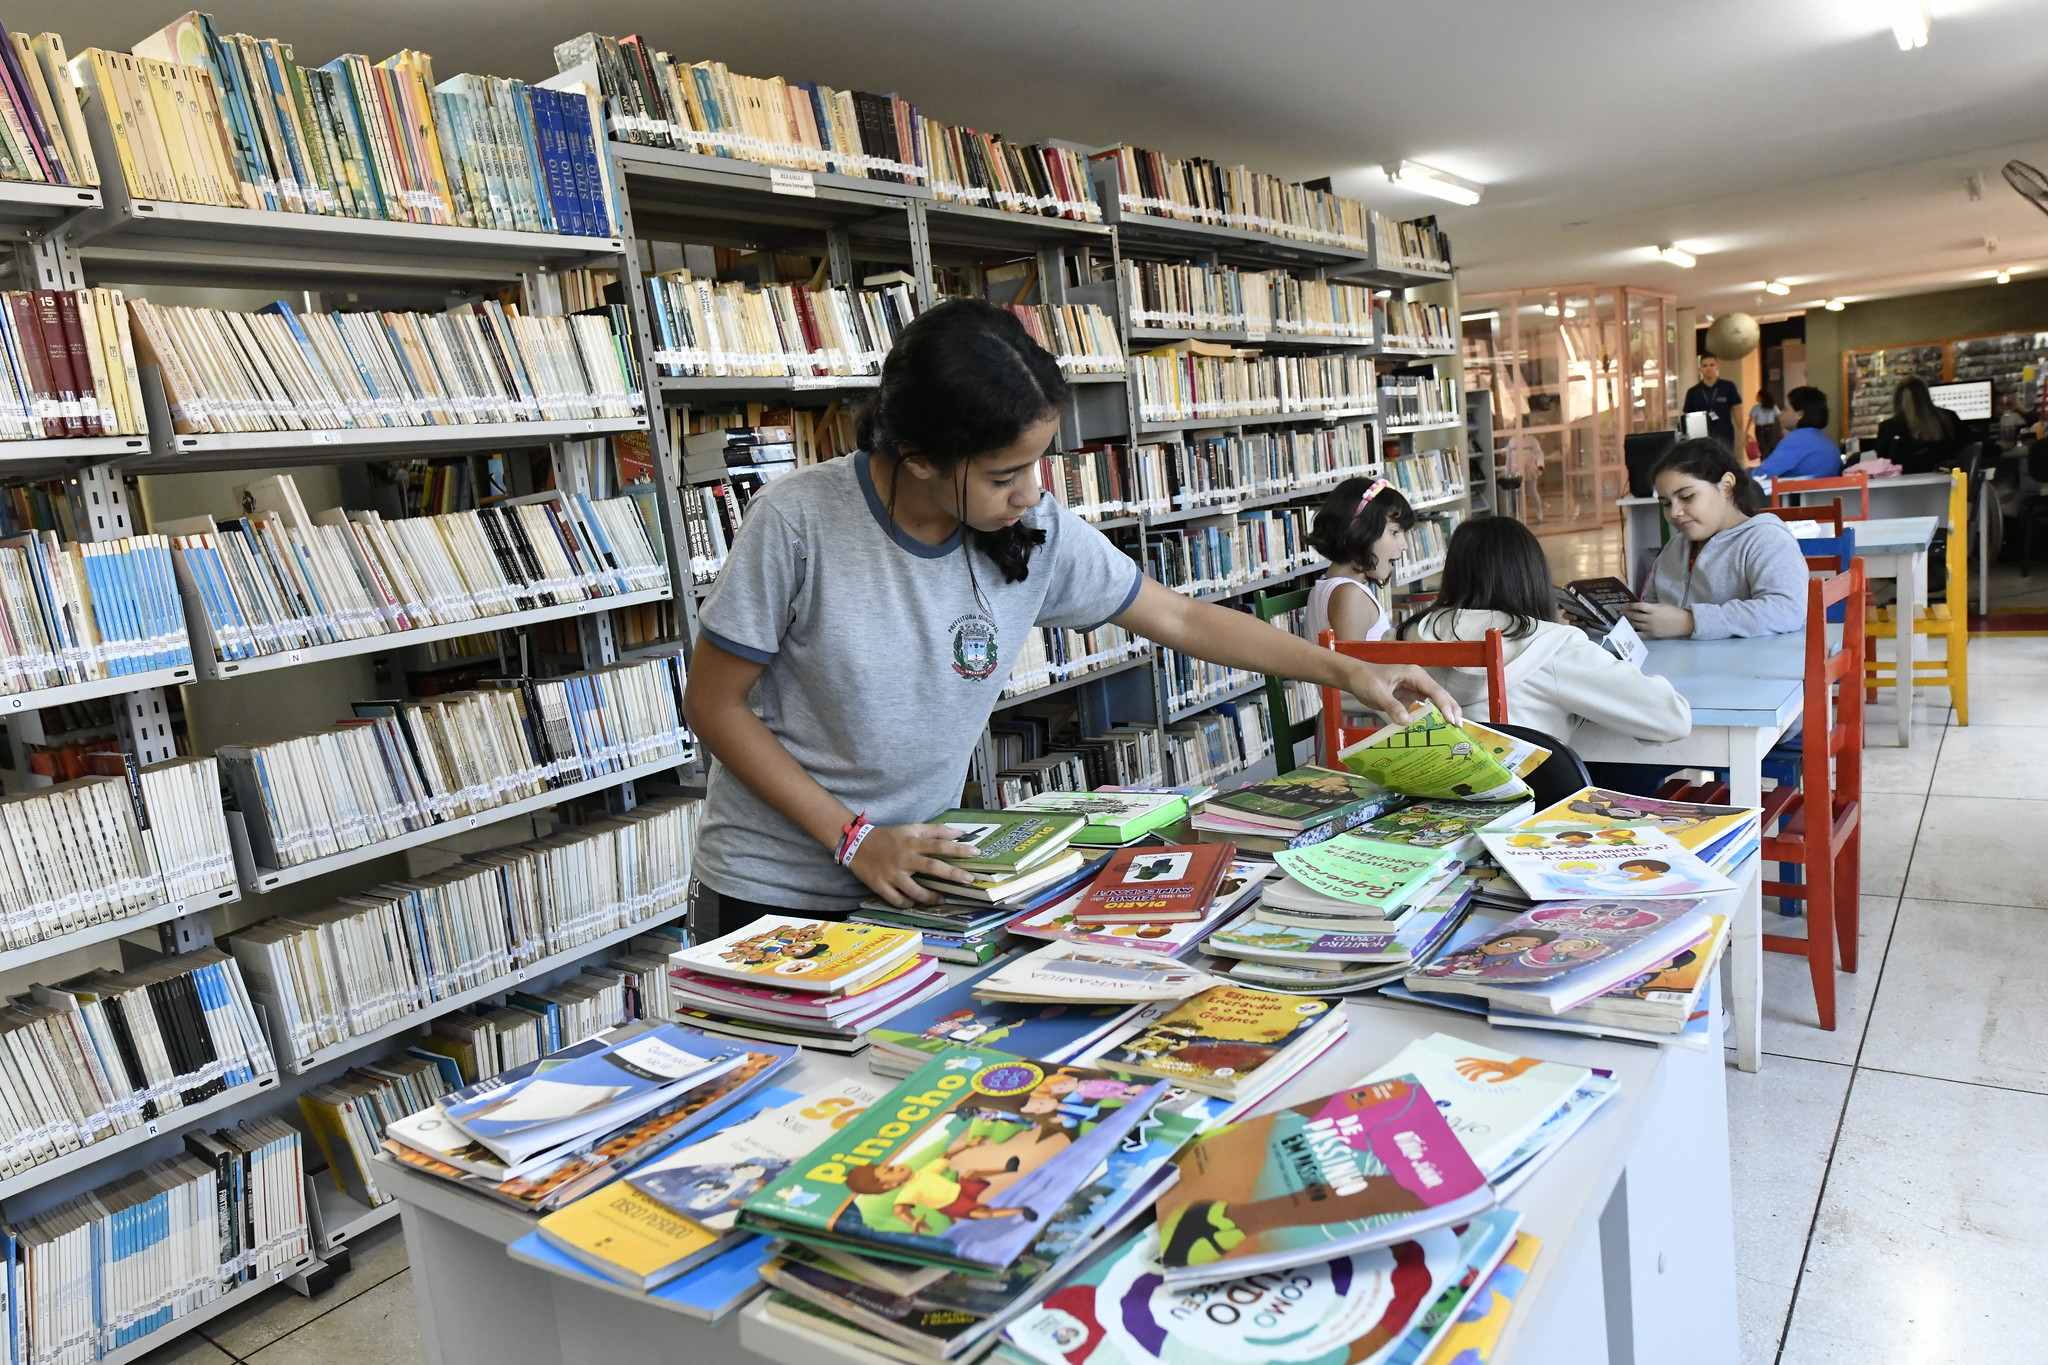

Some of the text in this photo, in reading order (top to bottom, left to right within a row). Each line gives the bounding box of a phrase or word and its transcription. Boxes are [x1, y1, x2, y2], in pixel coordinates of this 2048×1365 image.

[475, 122, 493, 177] MONTEIRO LOBATO
[485, 122, 501, 177] MONTEIRO LOBATO
[497, 124, 513, 179] MONTEIRO LOBATO
[505, 123, 520, 177] MONTEIRO LOBATO
[514, 126, 529, 179] MONTEIRO LOBATO
[39, 297, 55, 307] 15
[63, 298, 74, 306] 11
[948, 614, 1000, 634] PREFEITURA MUNICIPAL
[292, 654, 300, 662] N
[12, 699, 21, 708] O
[1013, 827, 1055, 852] DIÁRIO
[846, 851, 853, 861] DE
[1328, 844, 1429, 868] Descoladas
[1555, 852, 1648, 861] sexualidade
[1601, 844, 1670, 854] mentira?
[1324, 849, 1410, 874] Princesas
[1294, 855, 1395, 899] Paqueras
[1093, 887, 1194, 897] MINECRAFT
[1106, 894, 1155, 902] ZUMBI
[177, 905, 184, 914] P
[1103, 900, 1167, 909] DIÁRIO
[1319, 940, 1387, 949] MONTEIRO
[1207, 996, 1282, 1012] Encravado
[1224, 991, 1280, 1003] Espinho
[1199, 1012, 1259, 1026] Gigante
[1235, 1009, 1264, 1018] Ovo
[149, 1125, 157, 1134] R
[805, 1074, 967, 1185] Pinocho
[1335, 1114, 1364, 1136] DE
[1302, 1117, 1369, 1197] PASSINHO
[1281, 1133, 1303, 1156] EM
[1292, 1153, 1327, 1201] PASSINHO
[609, 1196, 646, 1222] DISCO
[646, 1210, 694, 1240] PERDIDO
[275, 1272, 282, 1280] T
[1206, 1267, 1288, 1325] UDO
[1253, 1275, 1312, 1328] COMO
